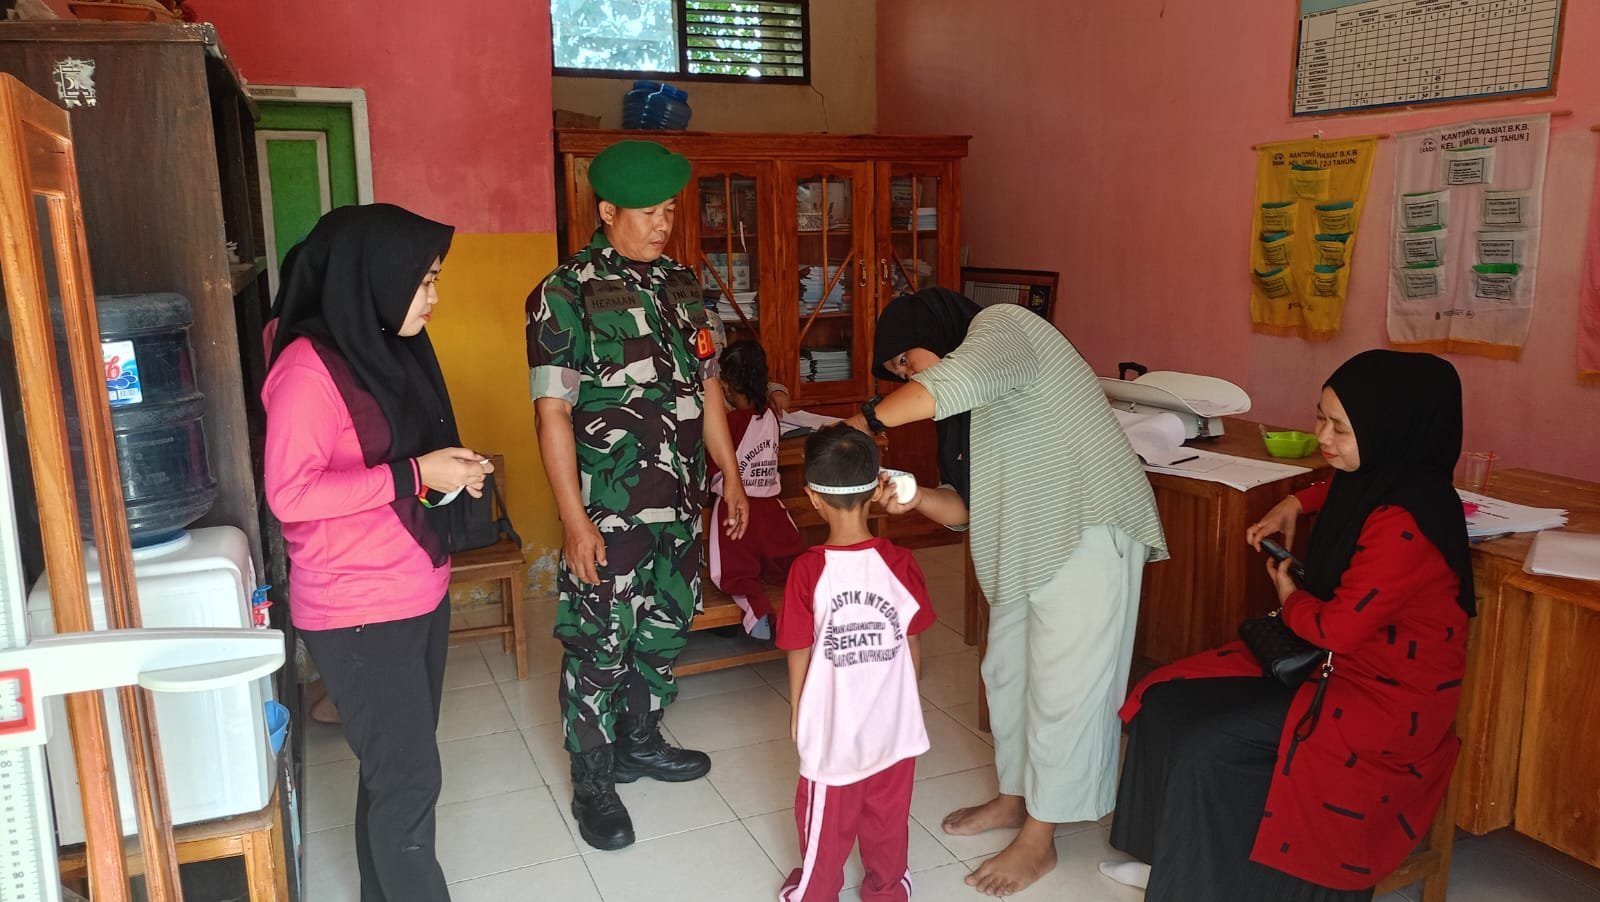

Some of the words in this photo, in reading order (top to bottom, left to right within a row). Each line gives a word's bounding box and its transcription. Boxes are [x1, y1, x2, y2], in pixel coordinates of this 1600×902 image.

[1441, 128, 1477, 141] KANTONG
[1478, 125, 1506, 136] WASIAT
[592, 296, 636, 309] HERMAN
[832, 632, 883, 651] SEHATI
